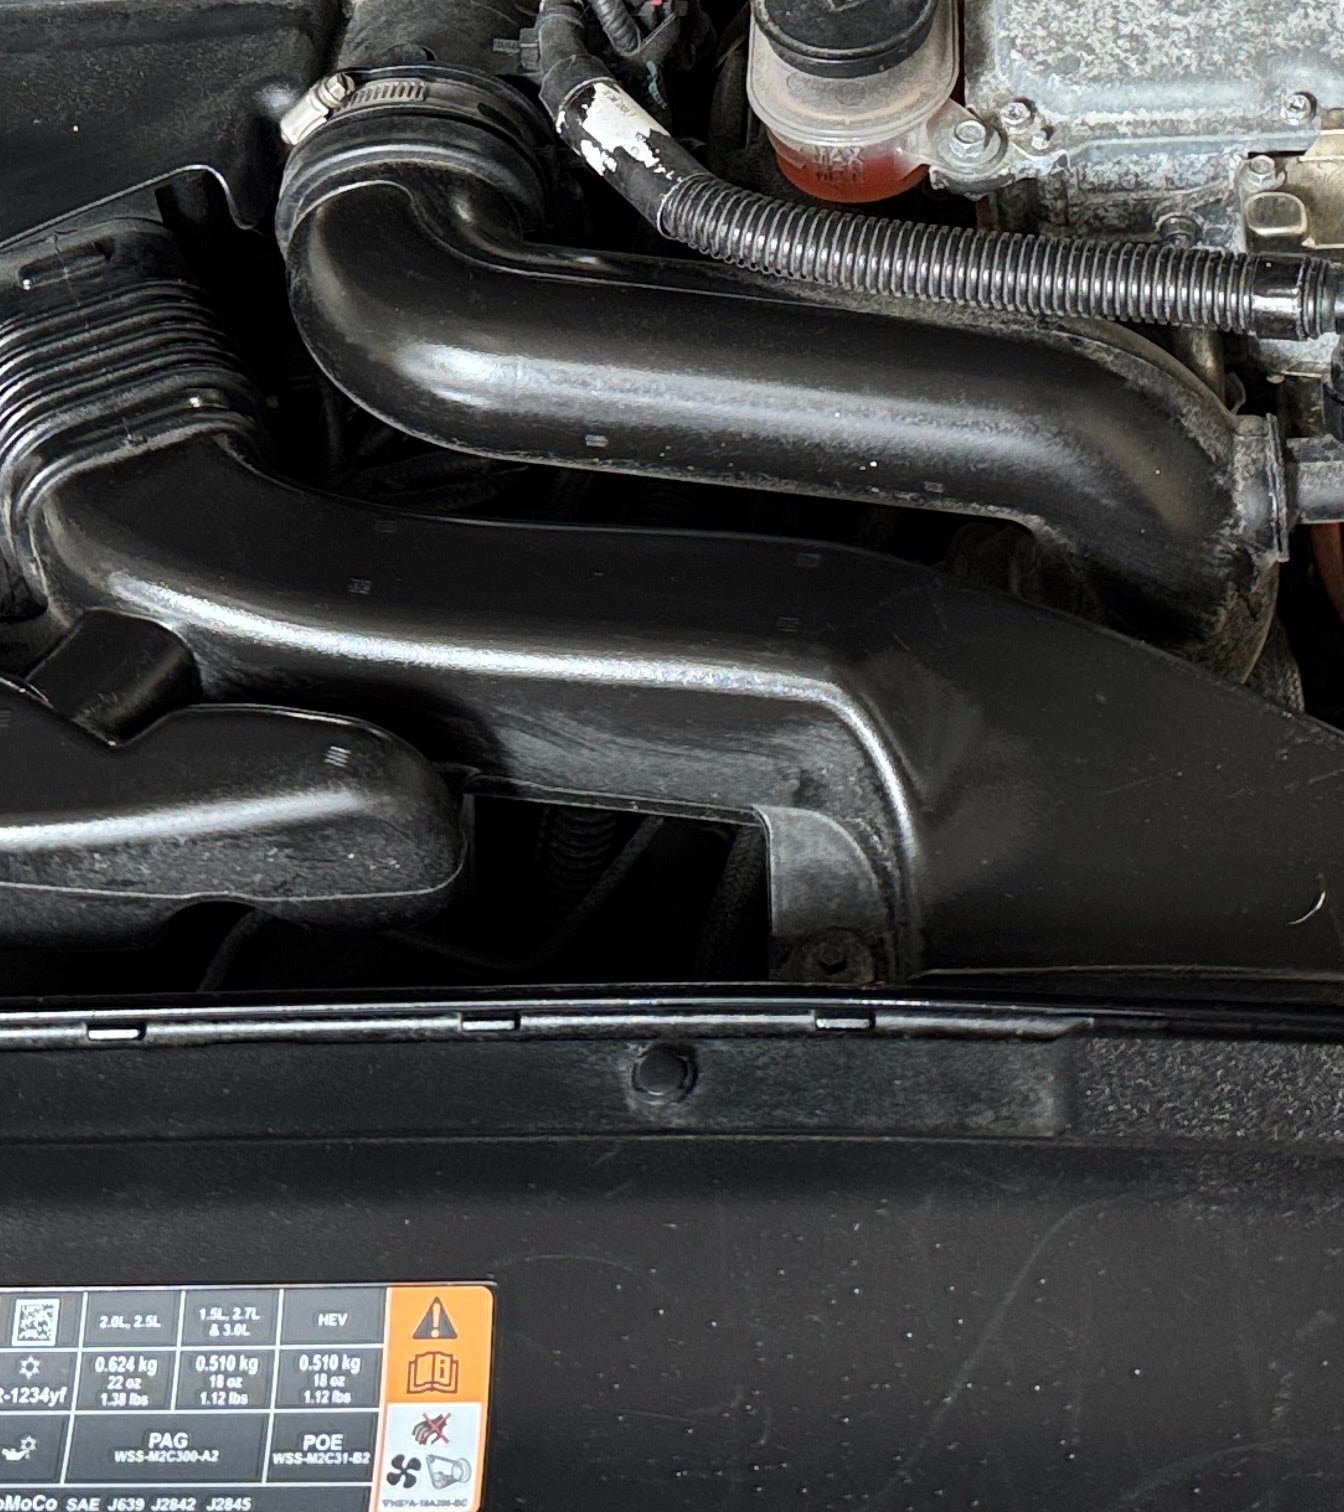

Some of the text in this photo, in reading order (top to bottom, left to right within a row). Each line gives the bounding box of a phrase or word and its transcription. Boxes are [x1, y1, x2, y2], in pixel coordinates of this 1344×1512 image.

[199, 1306, 261, 1322] 1.5L, 2.7L
[318, 1312, 349, 1327] HEV
[99, 1314, 162, 1330] 2.0L, 2.5L
[208, 1323, 251, 1337] & 3.0L
[94, 1355, 158, 1377] 0.624 kg
[195, 1354, 259, 1375] 0.510 kg
[298, 1354, 361, 1375] 0.510 kg
[107, 1376, 142, 1390] 22 oz
[209, 1374, 243, 1389] 18 oz
[313, 1373, 346, 1388] 18 oz
[128, 1392, 149, 1406] lbs
[200, 1391, 249, 1406] 1.12 lbs
[304, 1389, 352, 1404] 1.12 lbs
[148, 1432, 188, 1449] PAG
[302, 1433, 344, 1451] POE
[65, 1497, 101, 1512] SAE
[107, 1497, 146, 1512] J639
[151, 1497, 197, 1512] J2842
[205, 1497, 252, 1512] J2845
